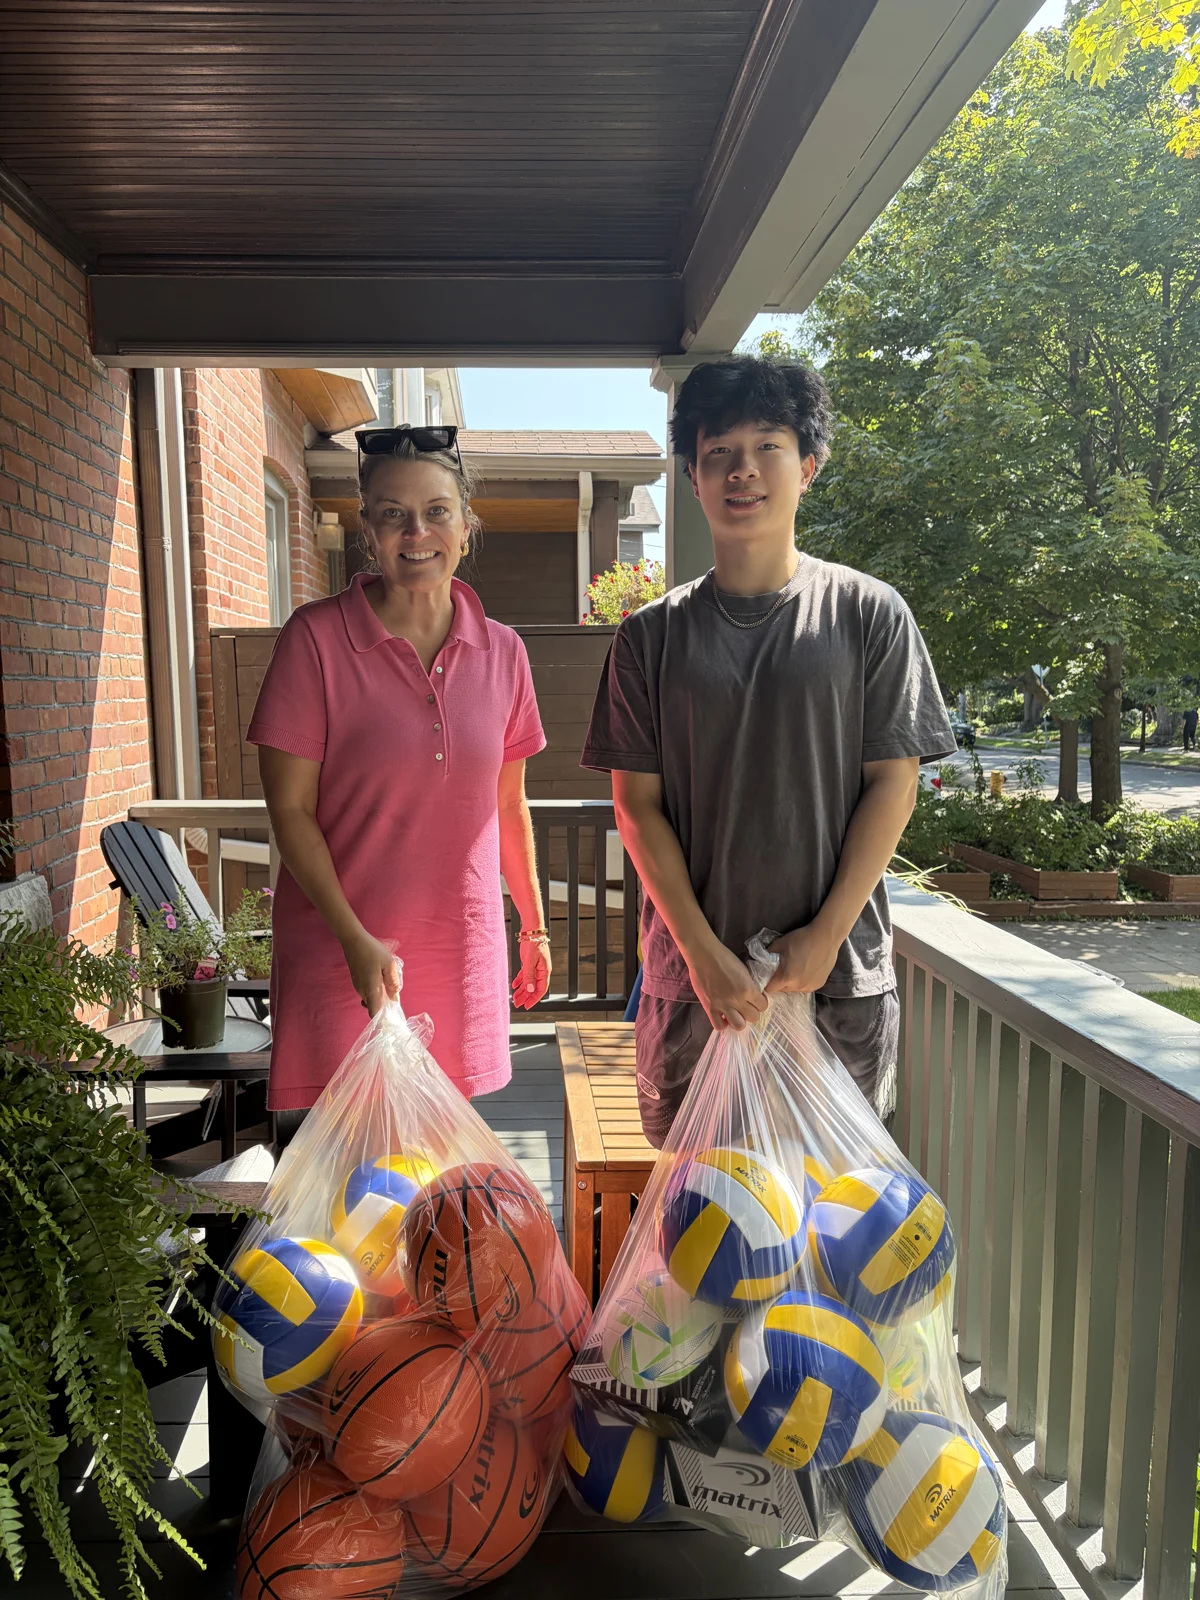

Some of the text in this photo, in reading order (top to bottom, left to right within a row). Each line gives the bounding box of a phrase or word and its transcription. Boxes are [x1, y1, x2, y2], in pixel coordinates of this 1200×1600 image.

[365, 1252, 385, 1277] MATRIX
[681, 1396, 694, 1415] 4
[692, 1485, 786, 1519] matrix
[929, 1485, 956, 1522] MATRIX
